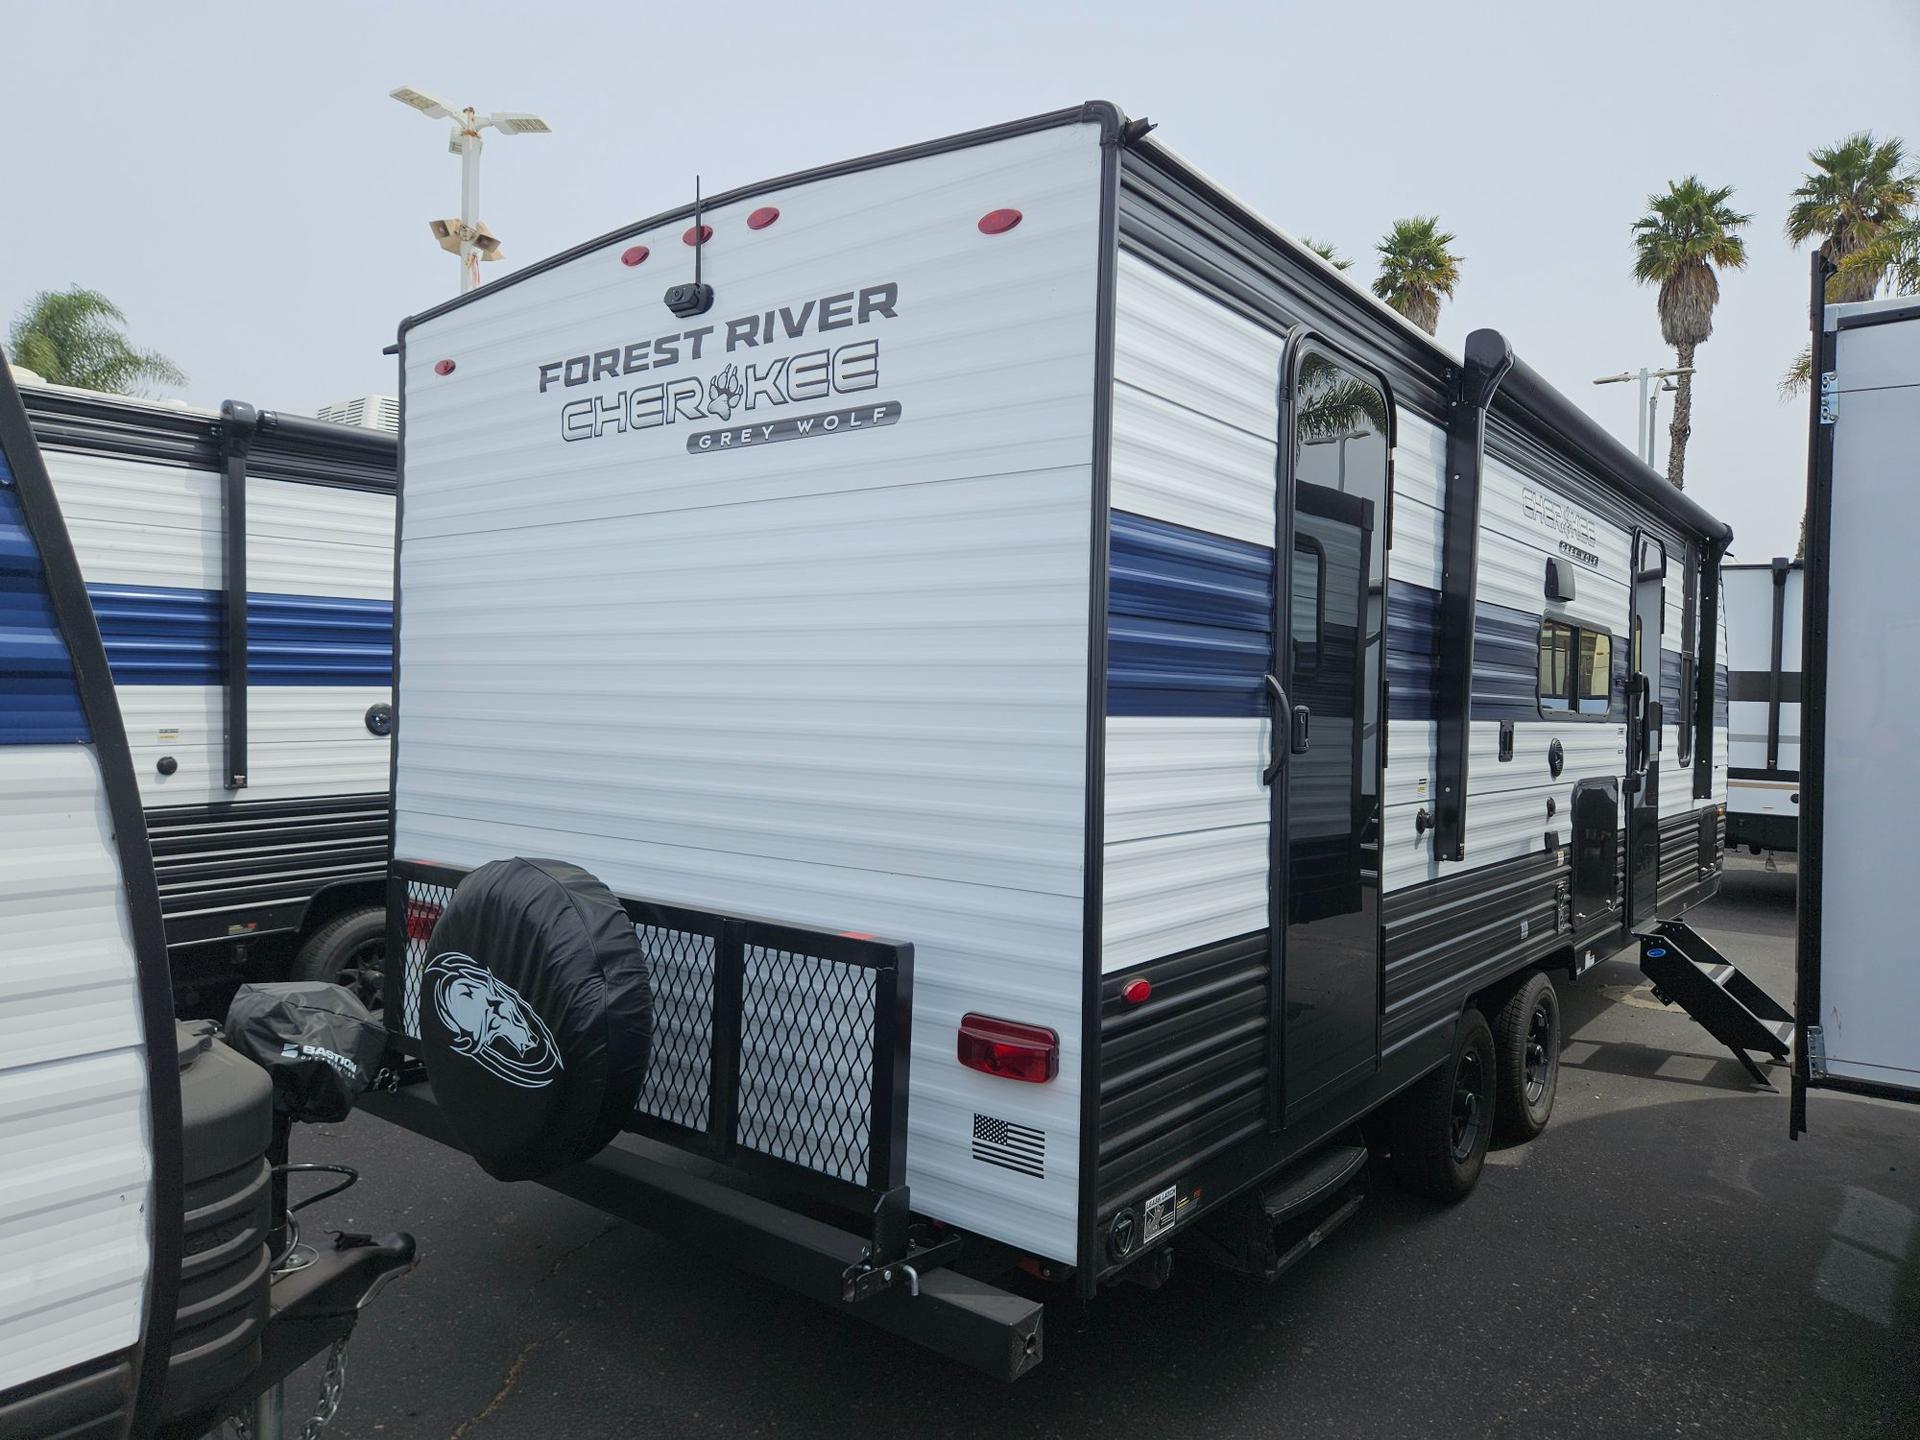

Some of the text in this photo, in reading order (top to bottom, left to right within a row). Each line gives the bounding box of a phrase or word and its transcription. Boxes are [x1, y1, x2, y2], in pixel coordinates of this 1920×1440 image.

[539, 282, 898, 393] FOREST RIVER
[561, 338, 879, 442] CHERKEE
[698, 406, 887, 449] GREY WOLF
[1522, 487, 1596, 548] CHERKEE
[302, 1045, 357, 1073] BASTION
